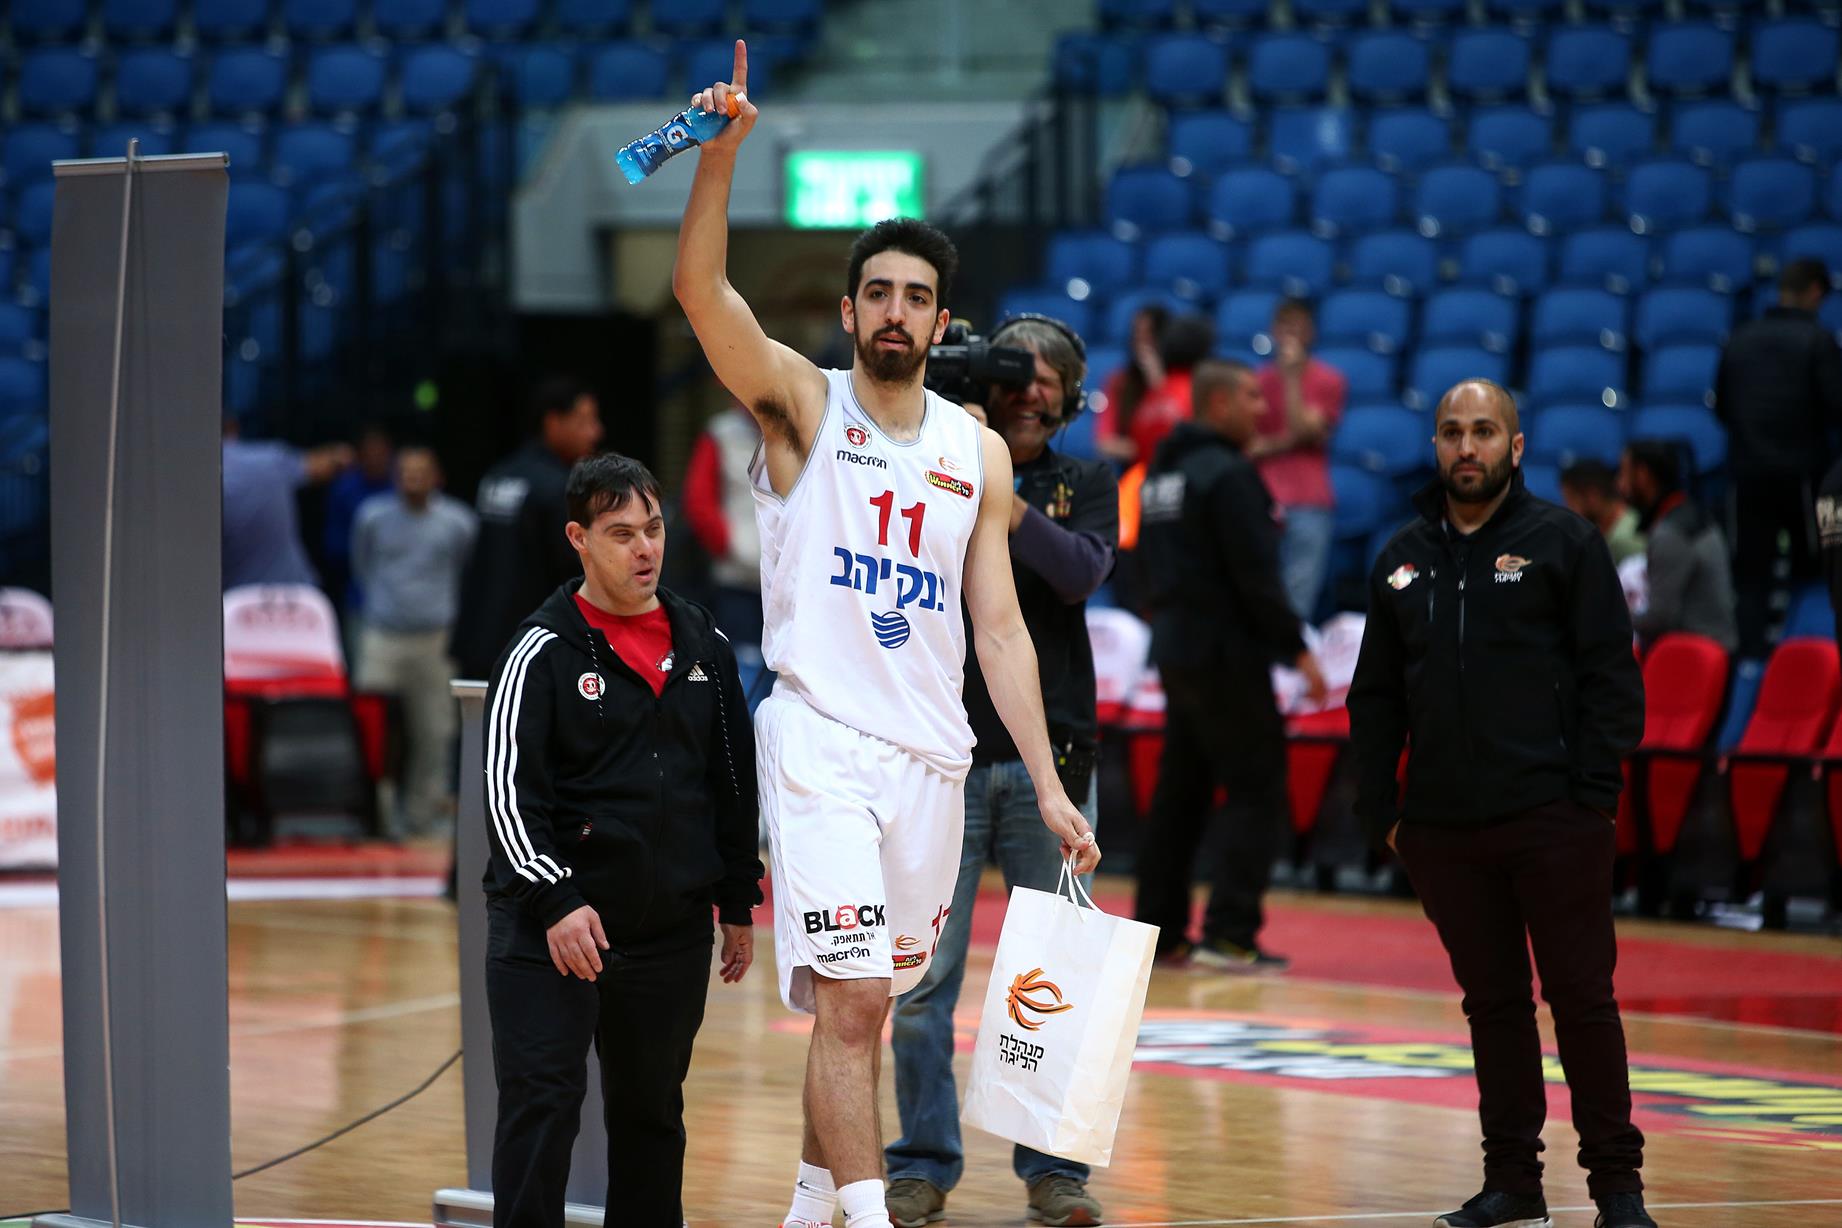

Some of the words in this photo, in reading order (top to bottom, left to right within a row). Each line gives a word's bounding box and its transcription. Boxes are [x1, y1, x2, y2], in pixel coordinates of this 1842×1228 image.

[836, 450, 887, 470] macron
[929, 473, 962, 493] Winner
[869, 489, 926, 559] 11
[830, 546, 892, 595] יהב
[817, 946, 870, 964] macron
[1000, 1034, 1044, 1059] מנהלת
[1000, 1049, 1038, 1072] הליגה
